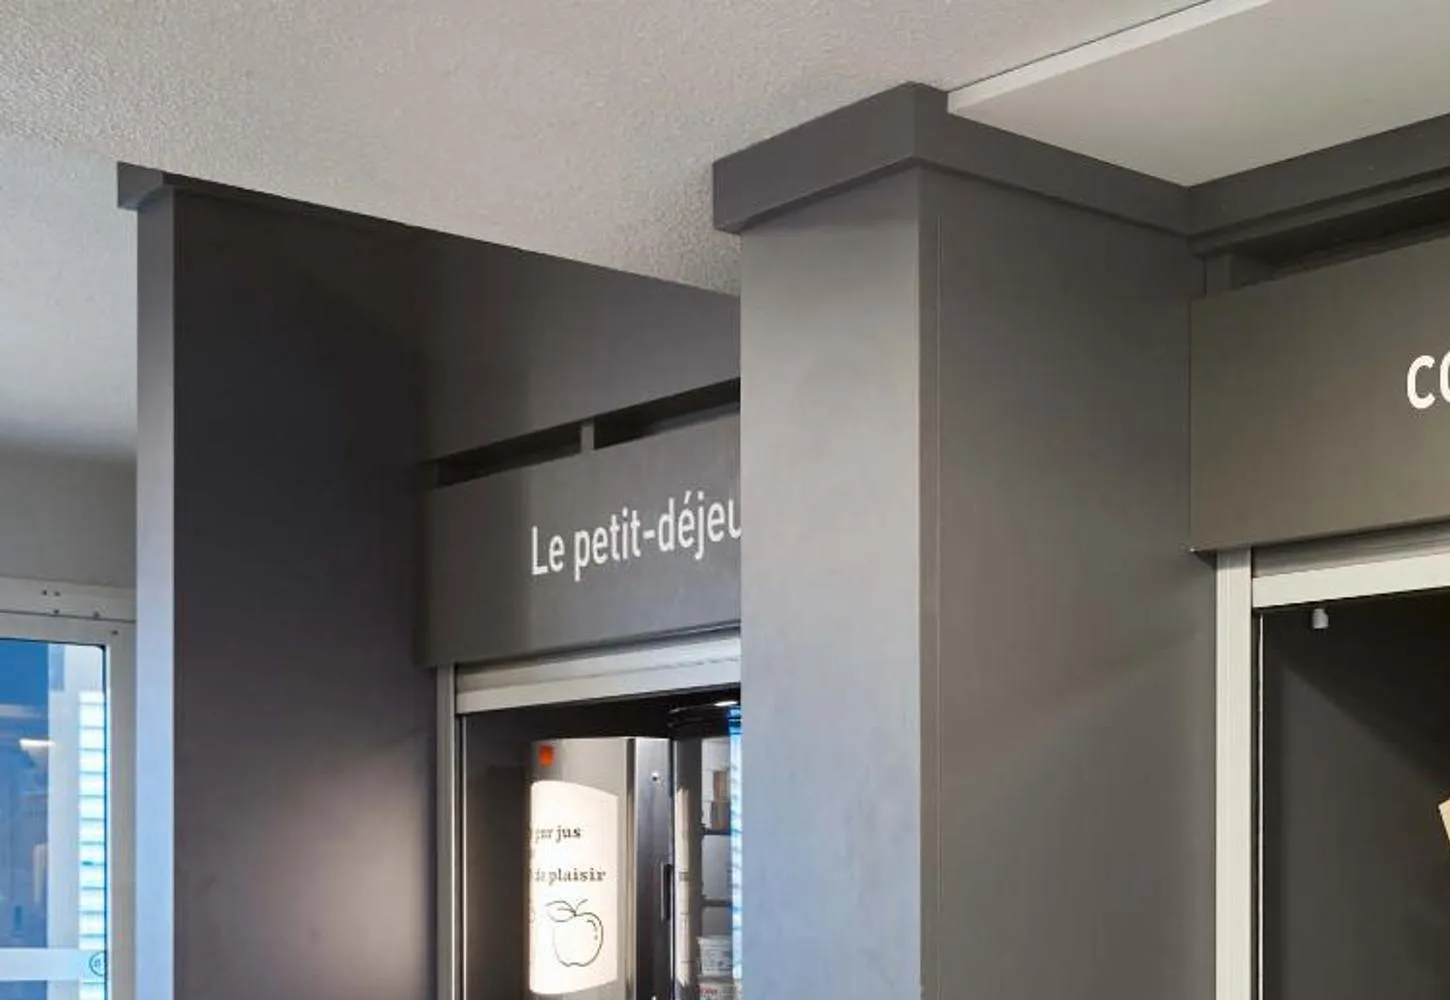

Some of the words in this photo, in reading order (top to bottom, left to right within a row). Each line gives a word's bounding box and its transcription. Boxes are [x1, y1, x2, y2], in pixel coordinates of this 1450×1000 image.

[531, 525, 566, 576] Le
[555, 825, 582, 843] jus
[548, 867, 606, 886] plaisir
